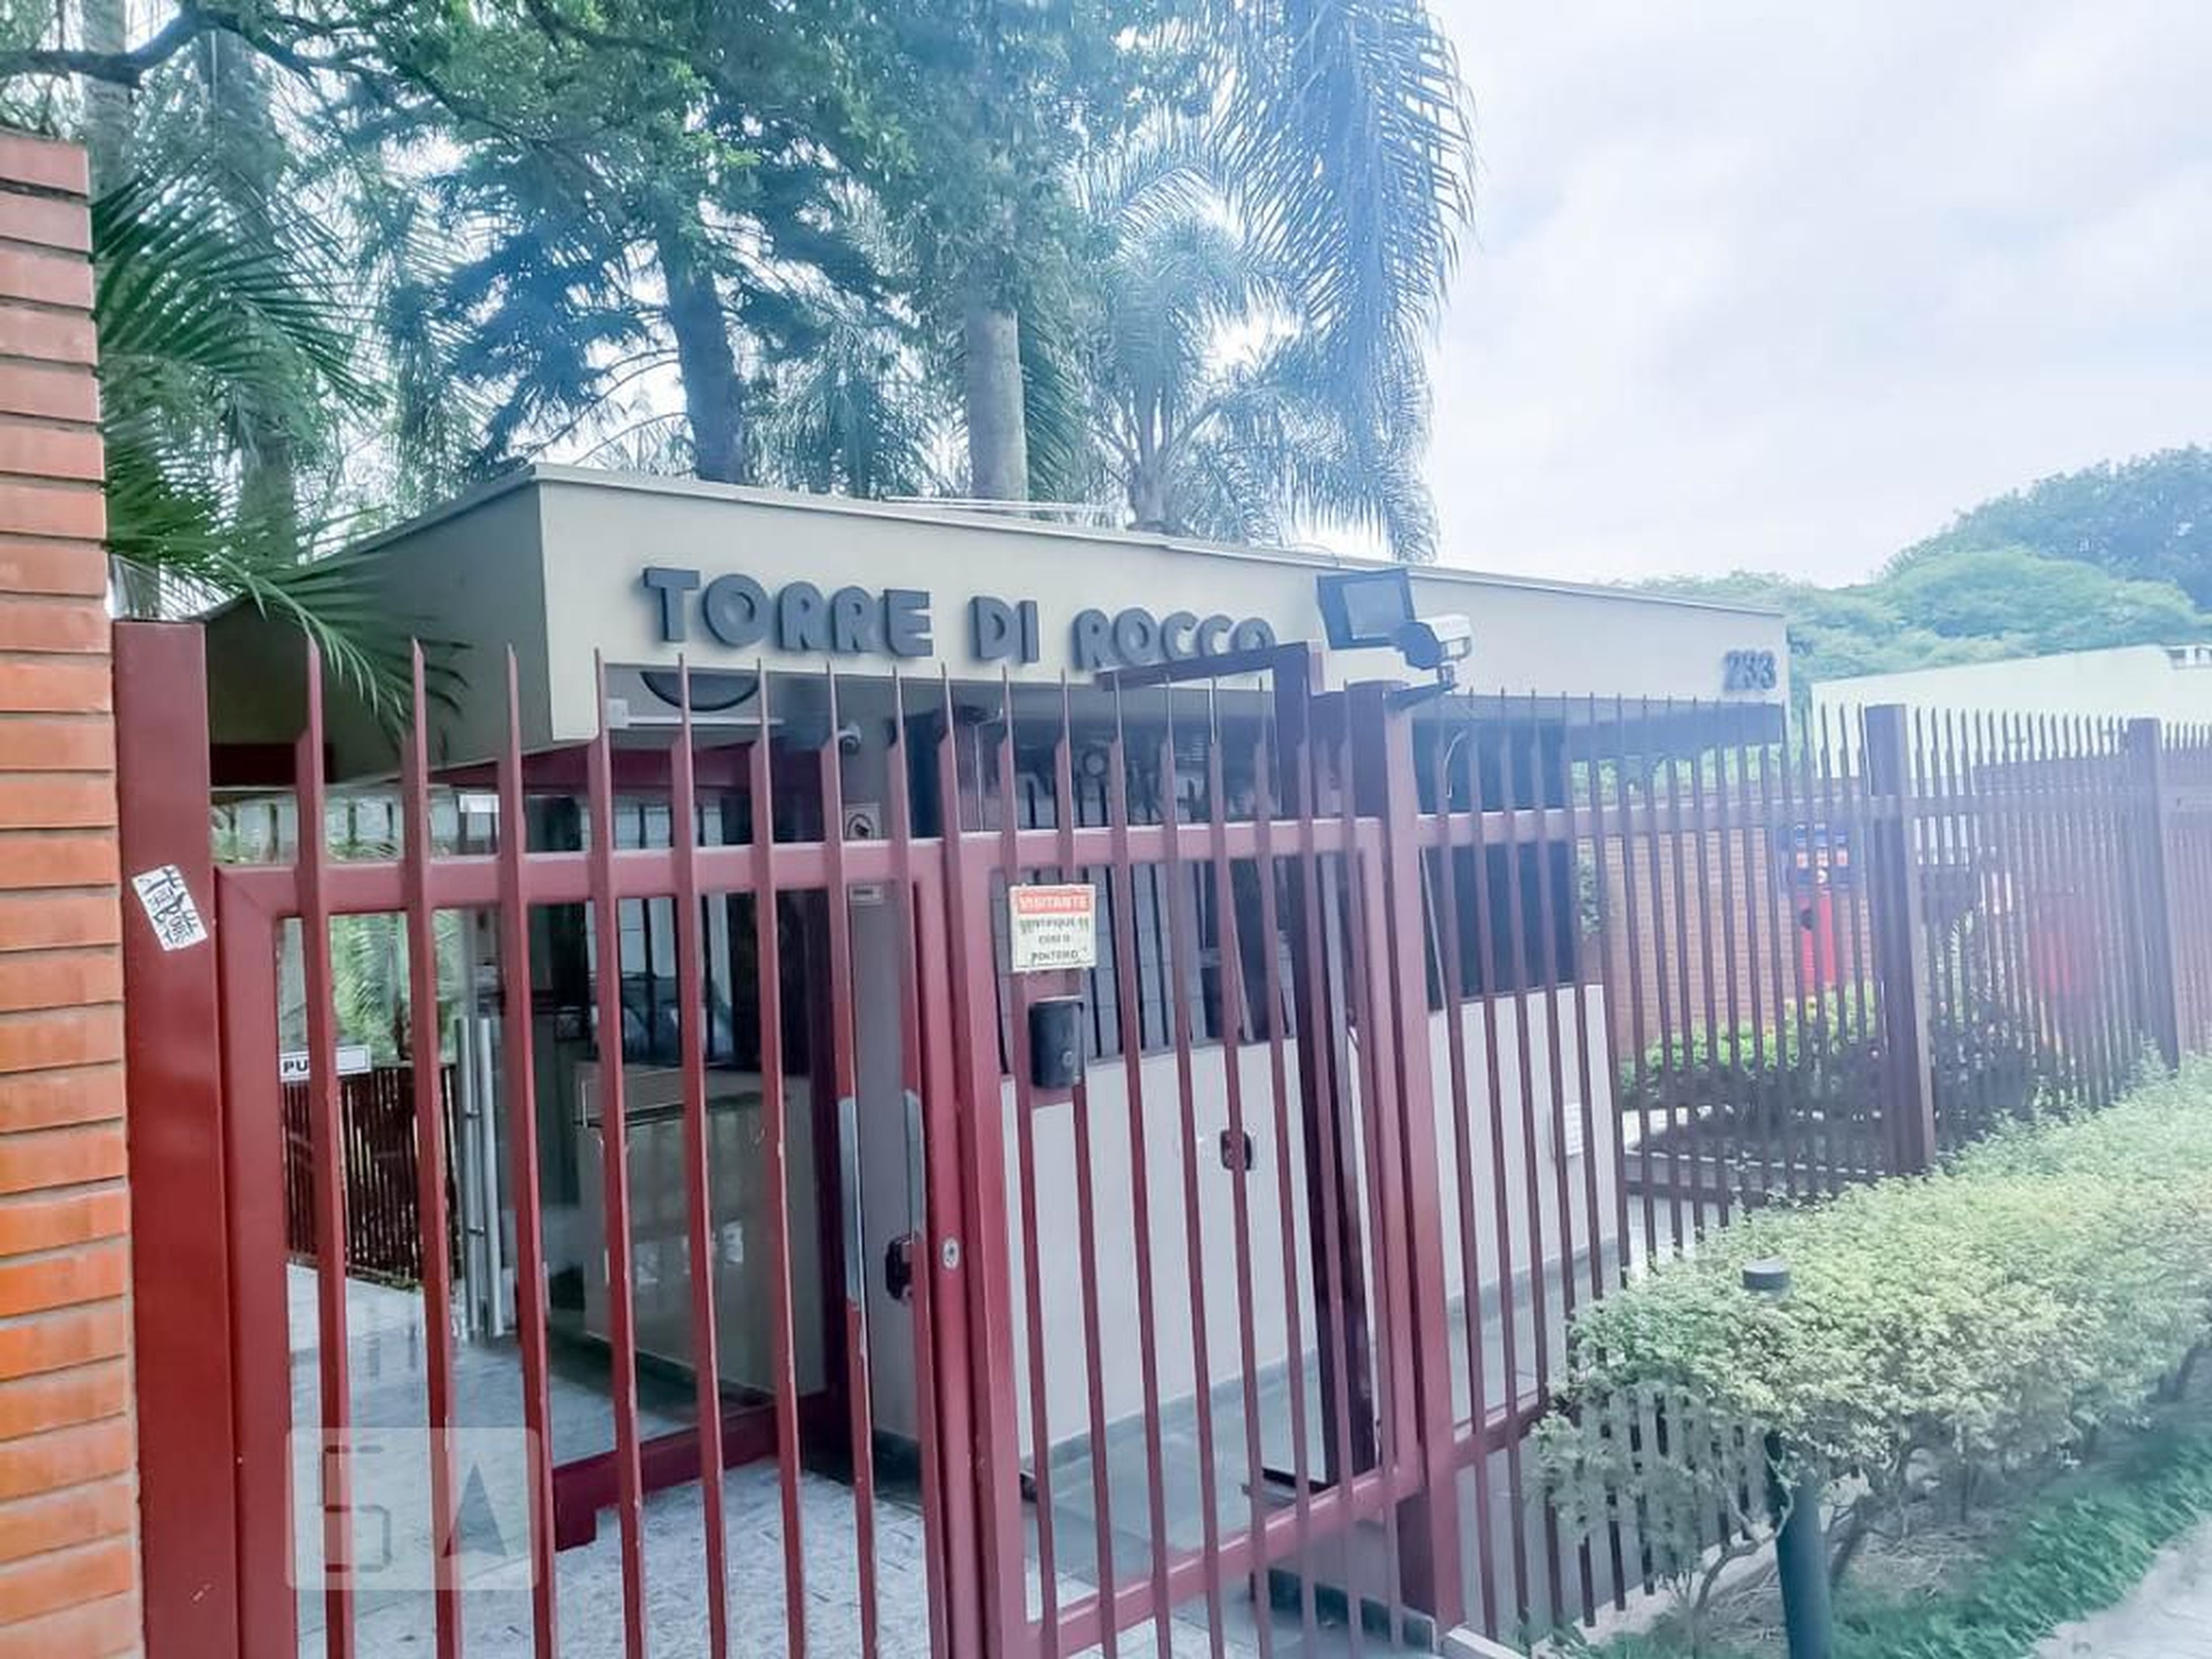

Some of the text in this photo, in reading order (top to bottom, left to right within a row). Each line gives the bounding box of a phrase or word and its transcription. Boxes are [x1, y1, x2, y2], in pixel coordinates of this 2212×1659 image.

[643, 566, 1275, 670] TORRE DI ROCCO
